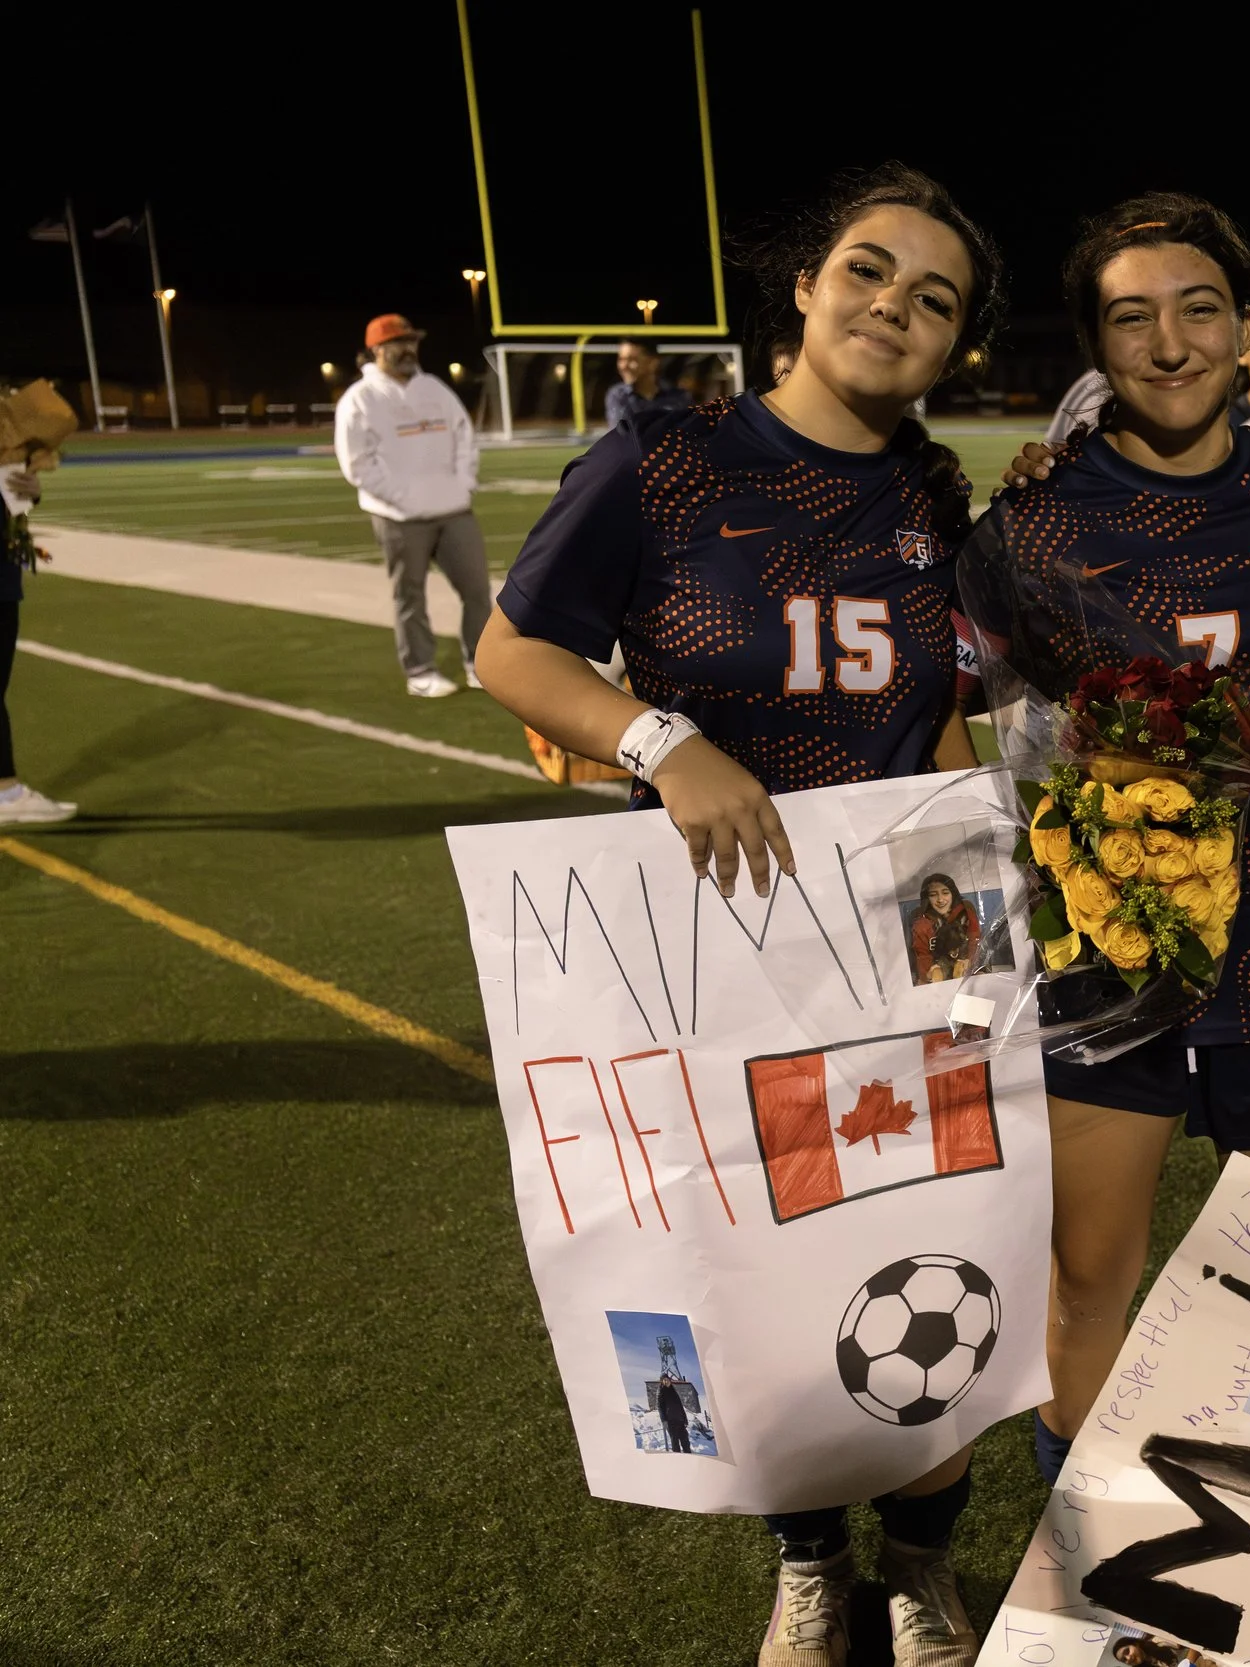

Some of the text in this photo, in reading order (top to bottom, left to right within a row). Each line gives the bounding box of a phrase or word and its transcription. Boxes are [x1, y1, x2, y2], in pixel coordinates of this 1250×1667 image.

[783, 595, 896, 695] 15
[1176, 609, 1241, 671] 7
[511, 842, 889, 1043] MIMI
[522, 1046, 737, 1235] FIFI
[1037, 1469, 1110, 1573] very
